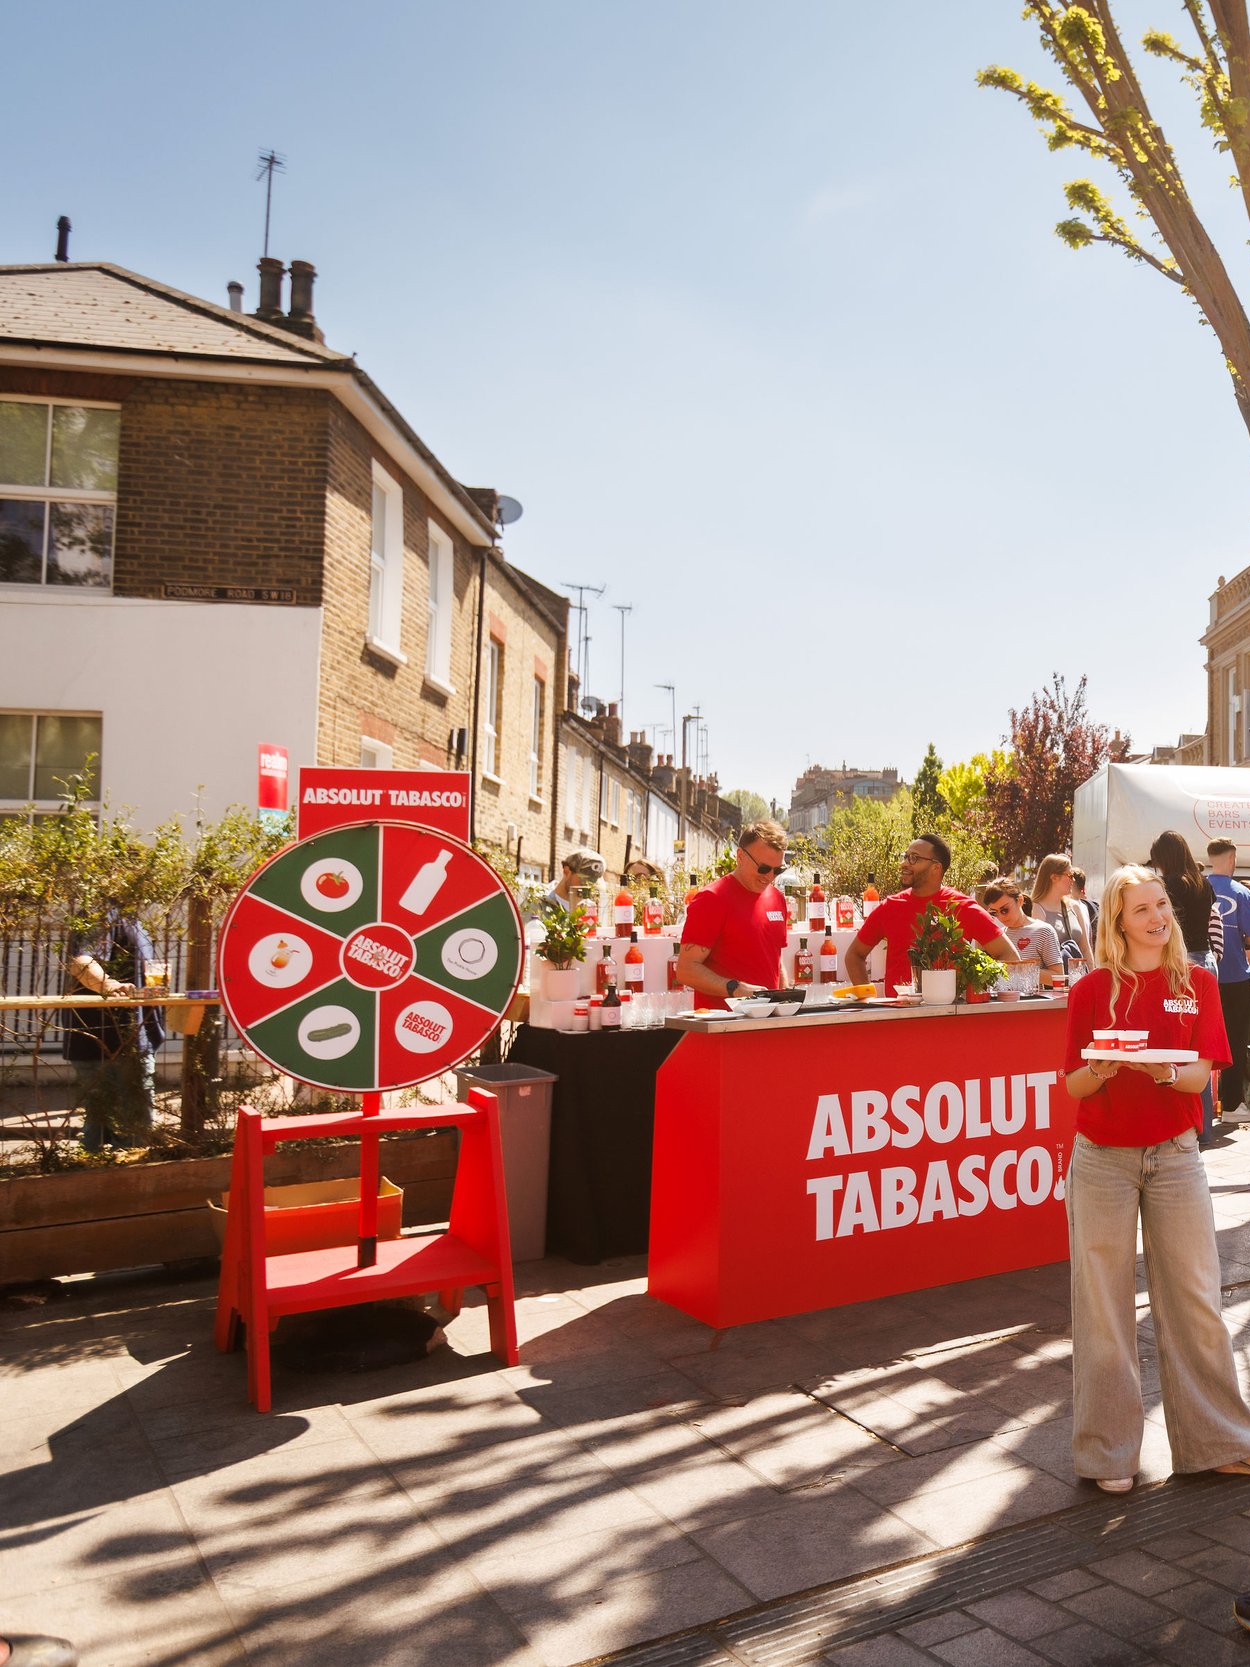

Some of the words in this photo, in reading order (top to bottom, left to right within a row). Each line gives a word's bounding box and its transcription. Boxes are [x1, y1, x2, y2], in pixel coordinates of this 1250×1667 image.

[166, 586, 218, 598] PODMORE
[227, 589, 256, 599] ROAD
[303, 788, 383, 805] ABSOLUT
[388, 790, 462, 808] TABASCO
[1208, 810, 1240, 818] BARS
[352, 935, 409, 967] ABSOLUT
[402, 1019, 440, 1042] TABASCO
[403, 1011, 446, 1034] ABSOLUT
[806, 1071, 1057, 1160] ABSOLUT
[806, 1146, 1053, 1241] TABASCO
